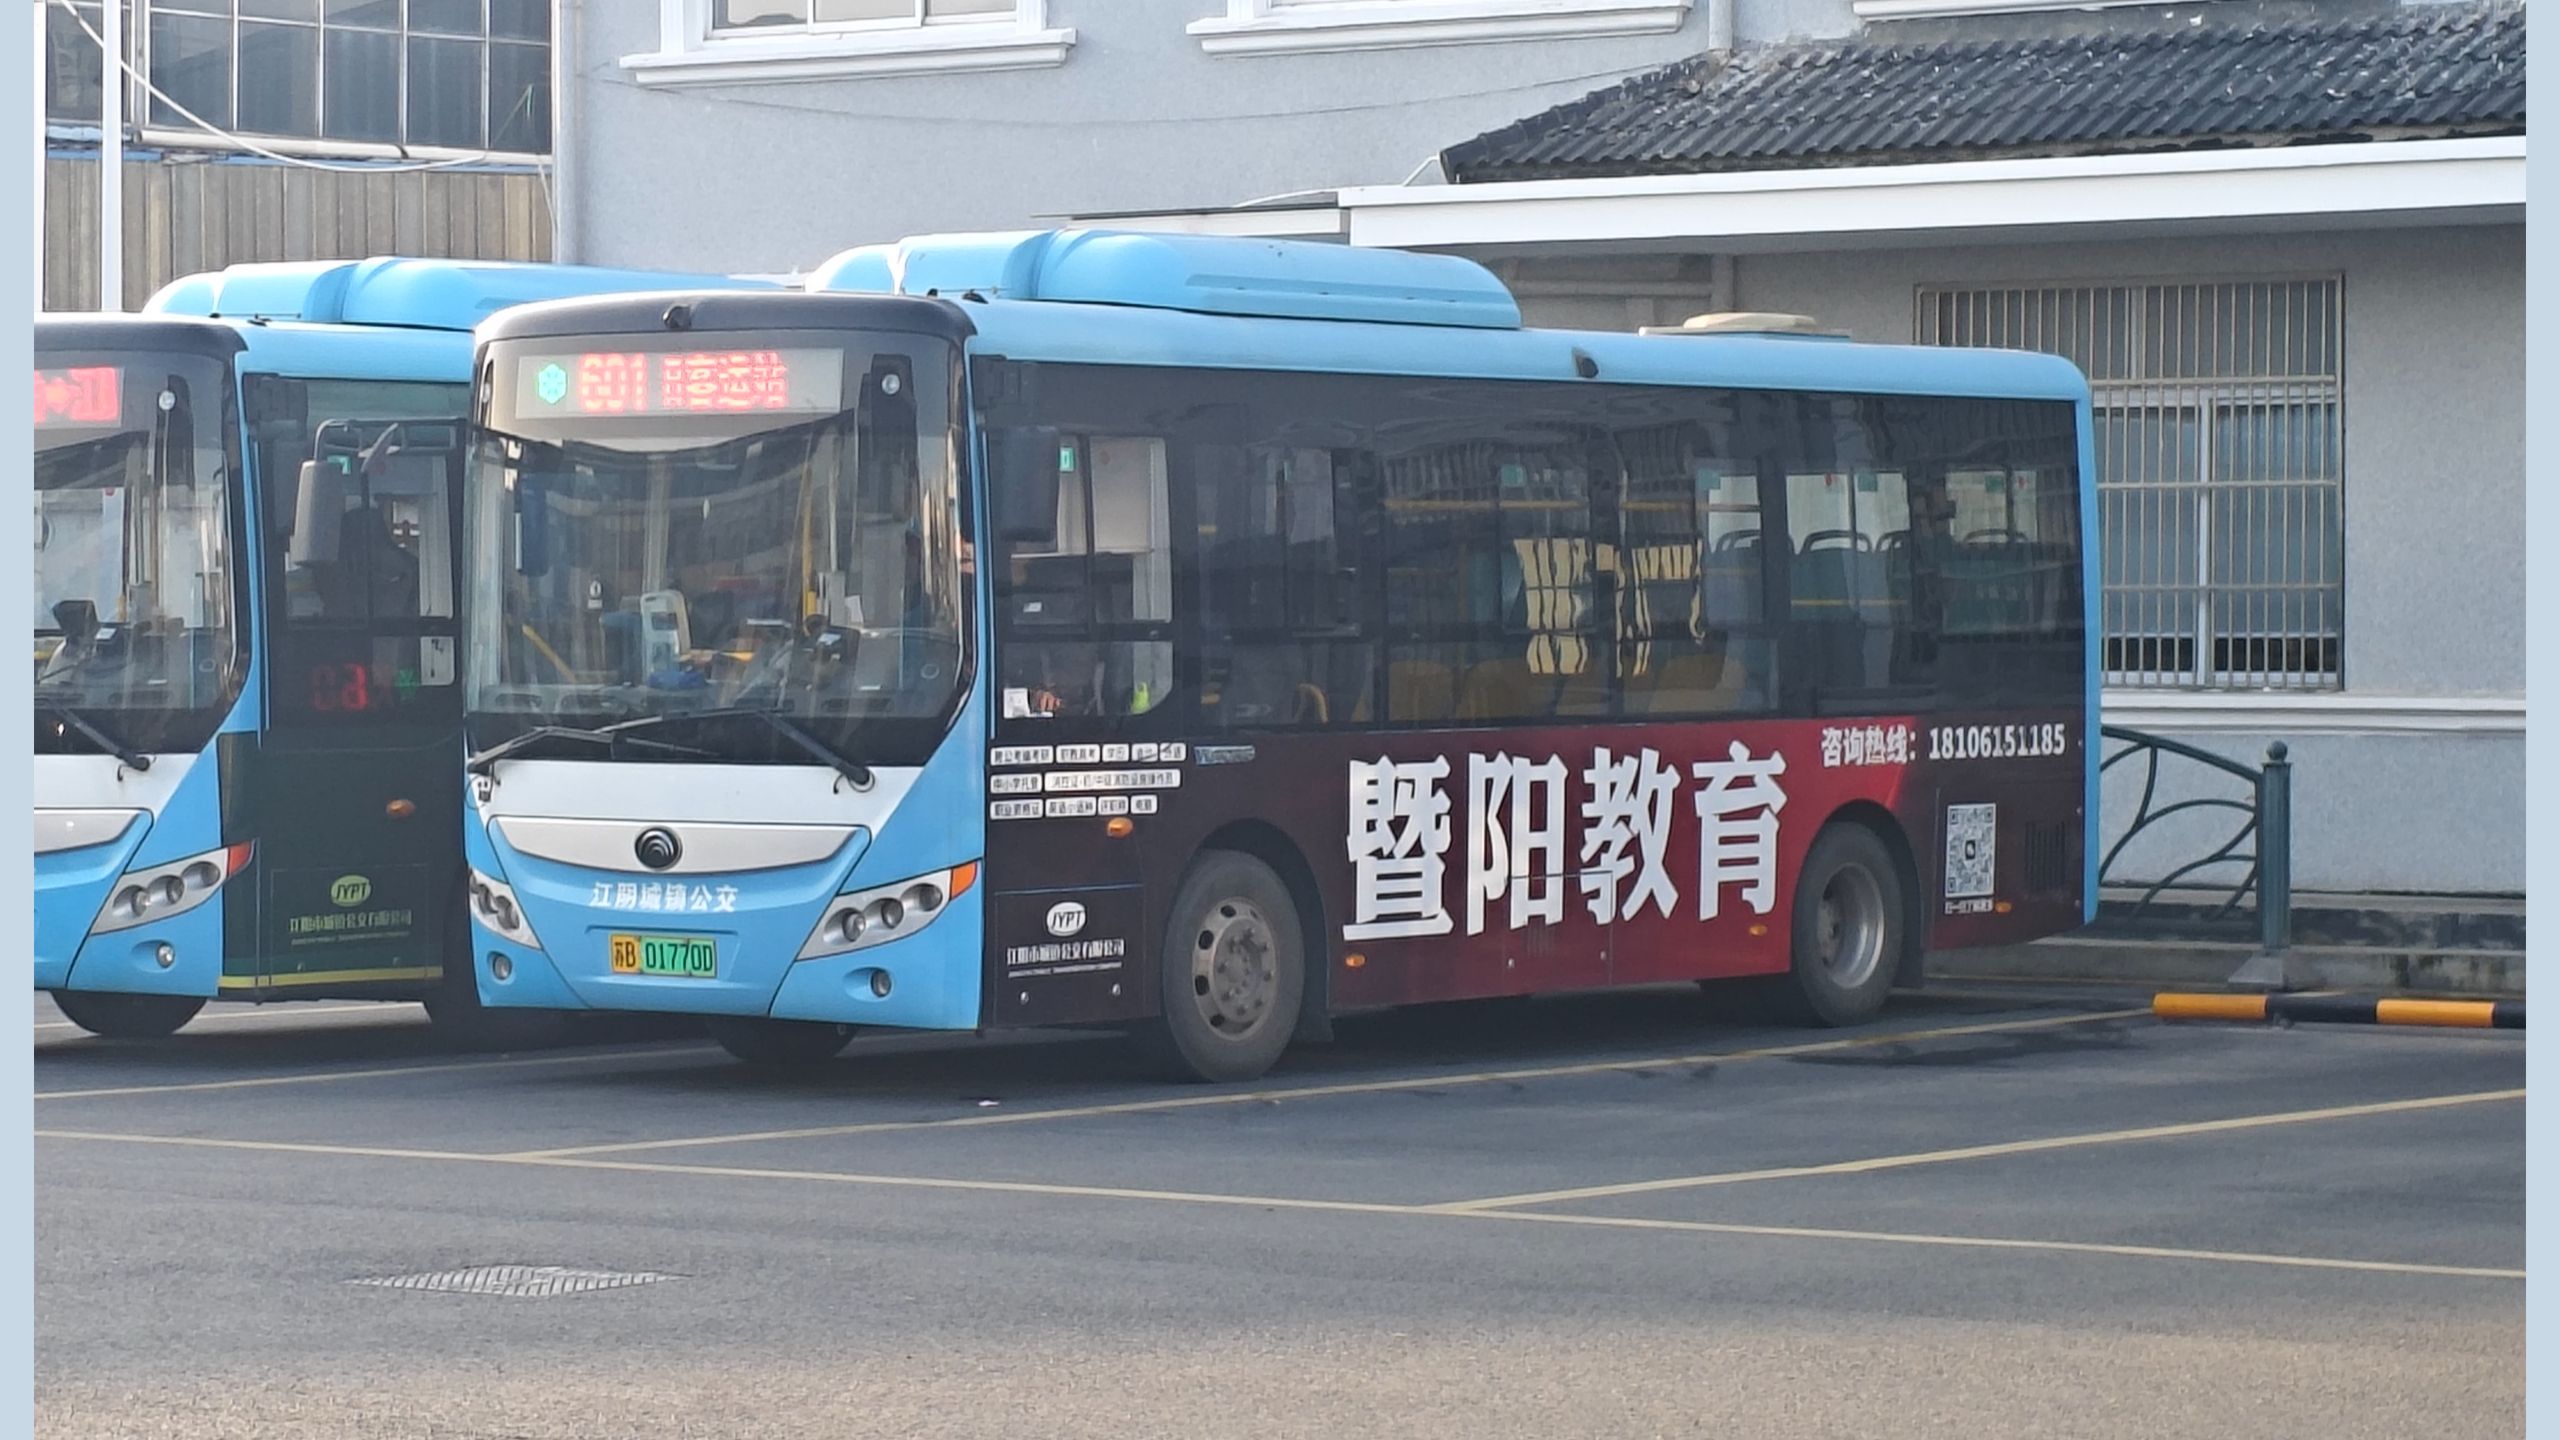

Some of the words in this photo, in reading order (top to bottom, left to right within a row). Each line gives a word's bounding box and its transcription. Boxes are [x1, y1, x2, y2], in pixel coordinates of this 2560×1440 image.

[582, 353, 644, 410] 601
[1929, 723, 2066, 760] 18106151185
[1343, 739, 1788, 942] 暨阳教育
[337, 882, 368, 900] JYPT
[590, 882, 739, 912] 江阴城镇公交
[1051, 910, 1085, 930] JYPT
[645, 942, 714, 972] 01770D
